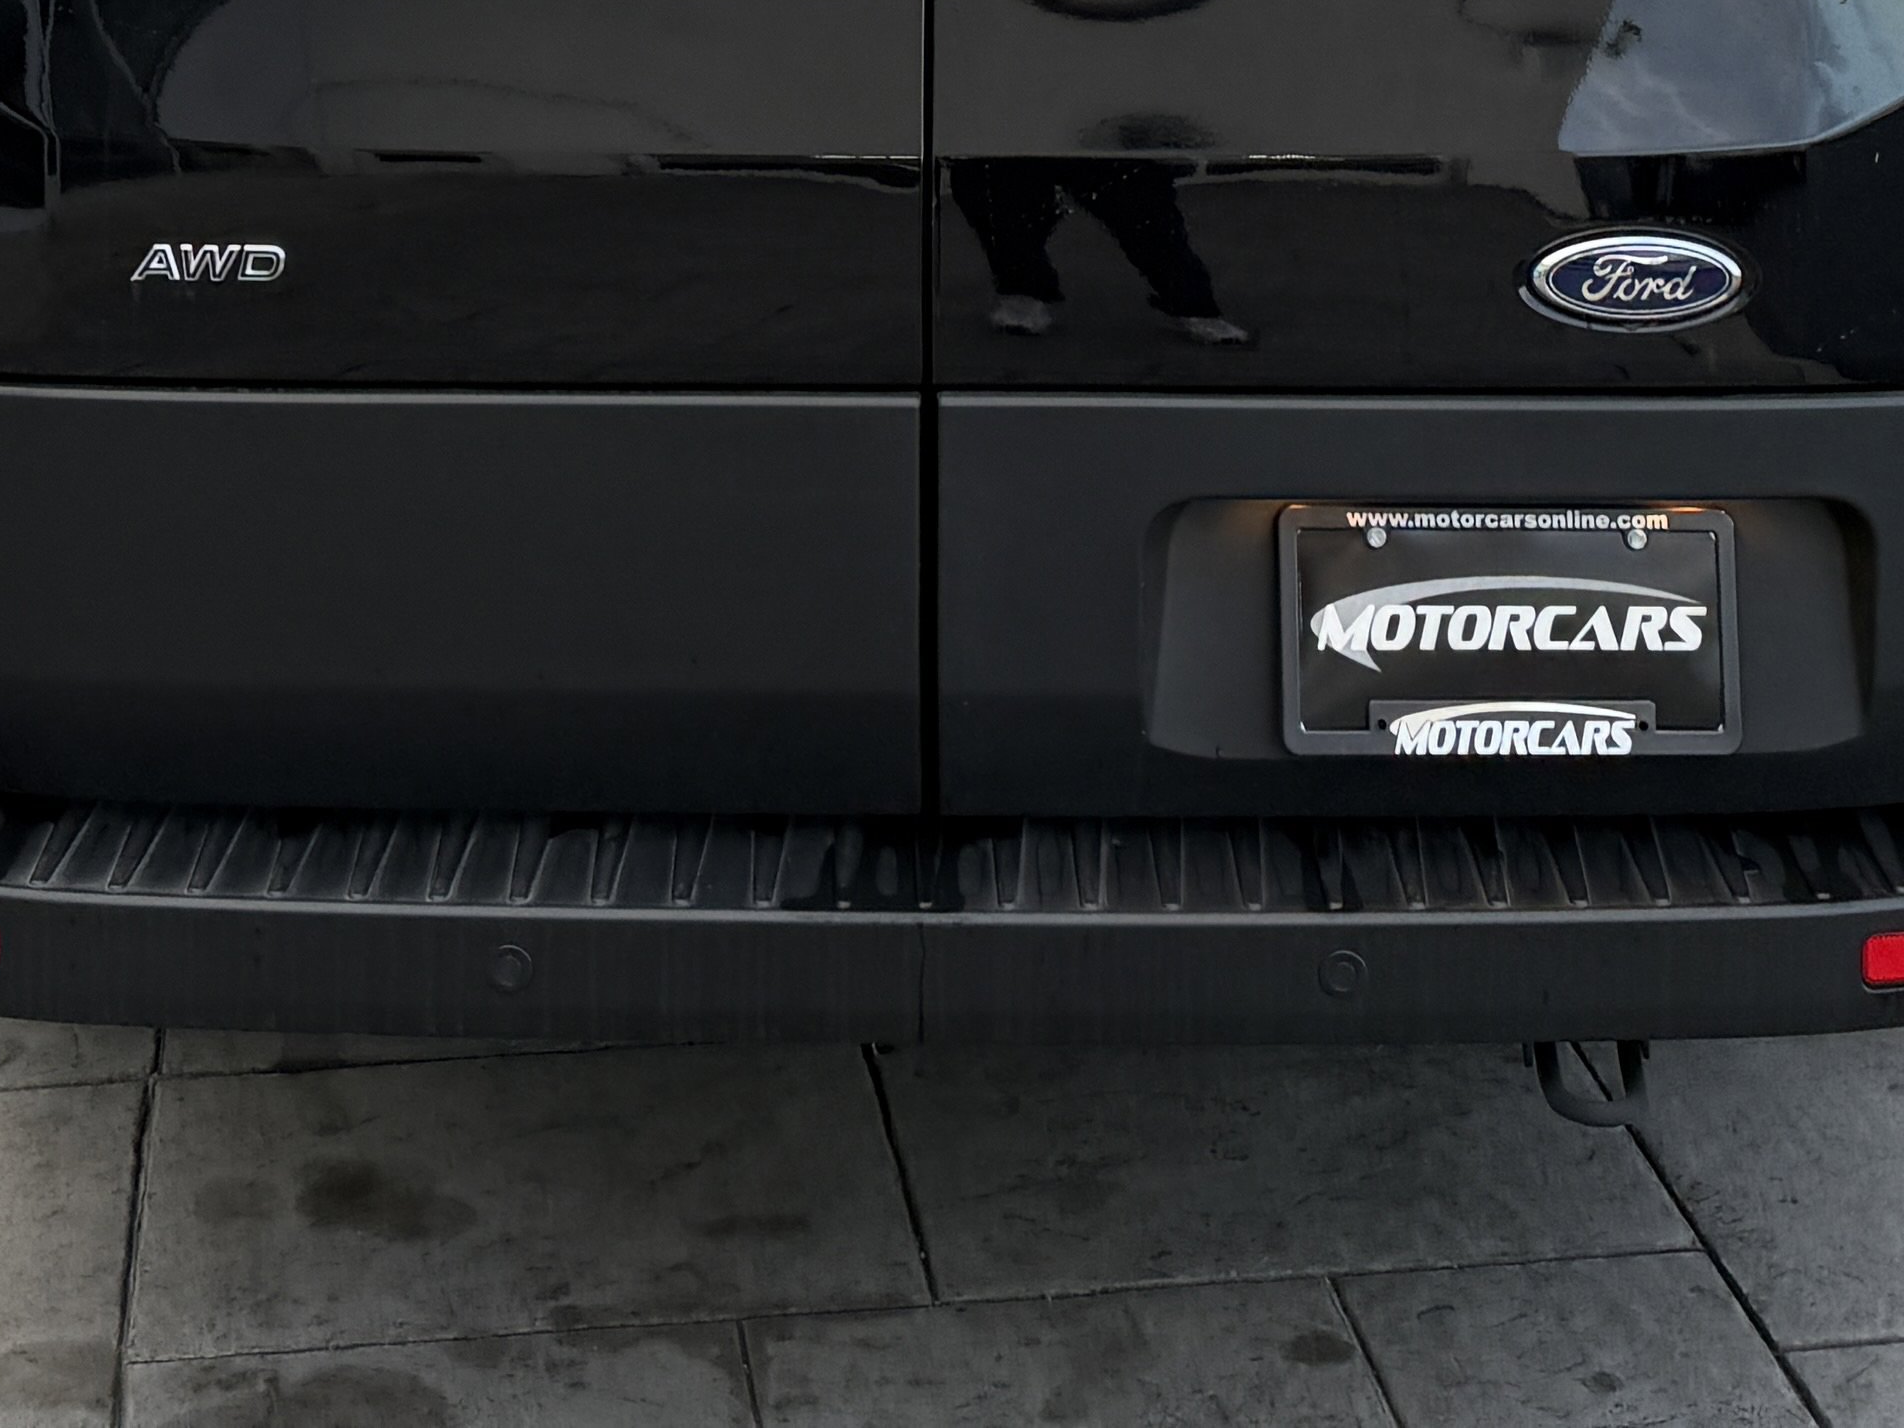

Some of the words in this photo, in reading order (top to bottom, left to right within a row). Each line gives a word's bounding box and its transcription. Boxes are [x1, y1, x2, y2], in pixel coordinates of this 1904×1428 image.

[129, 242, 286, 282] AWD
[1580, 253, 1697, 302] Ford
[1346, 510, 1670, 531] www.motorcarsonline.com
[1316, 603, 1708, 652] MOTORCARS
[1394, 719, 1637, 756] MOTORCARS
